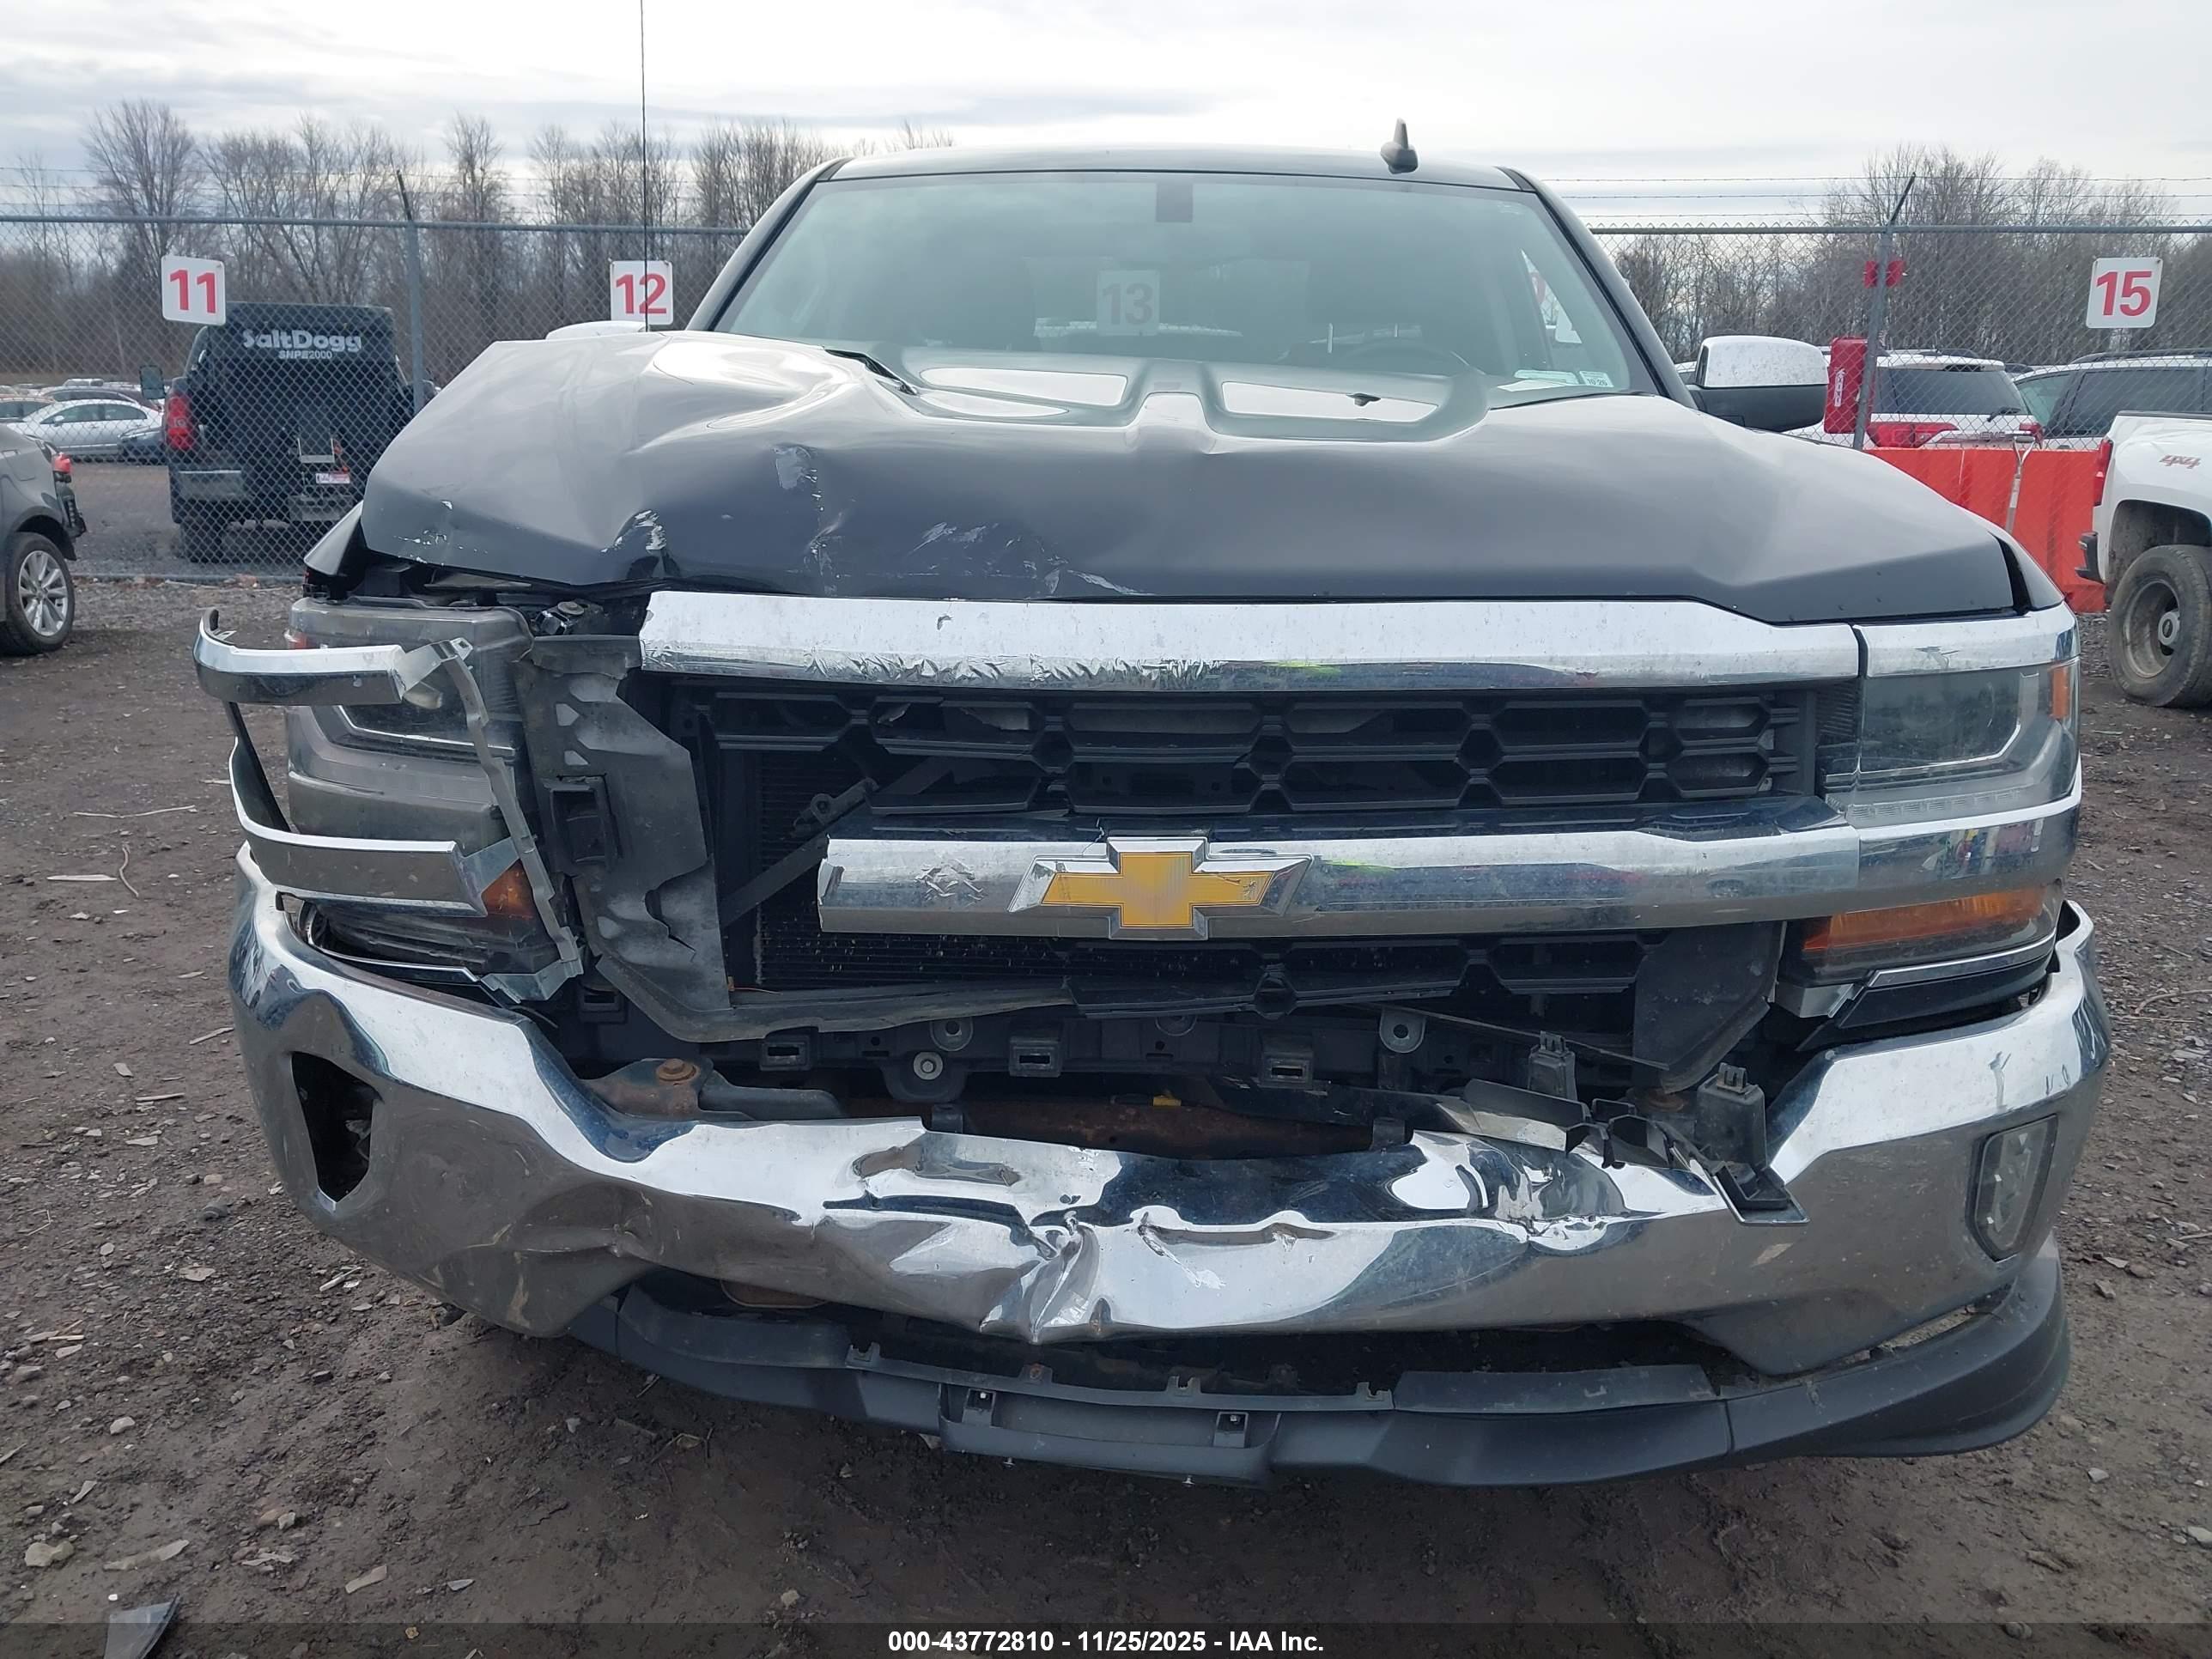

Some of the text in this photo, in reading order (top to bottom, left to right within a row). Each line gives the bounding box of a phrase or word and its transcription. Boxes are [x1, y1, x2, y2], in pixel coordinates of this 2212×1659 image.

[170, 269, 216, 314] 11
[616, 273, 667, 314] 12
[1102, 282, 1154, 325] 13
[2096, 270, 2153, 317] 15
[243, 329, 362, 353] SaltDogg
